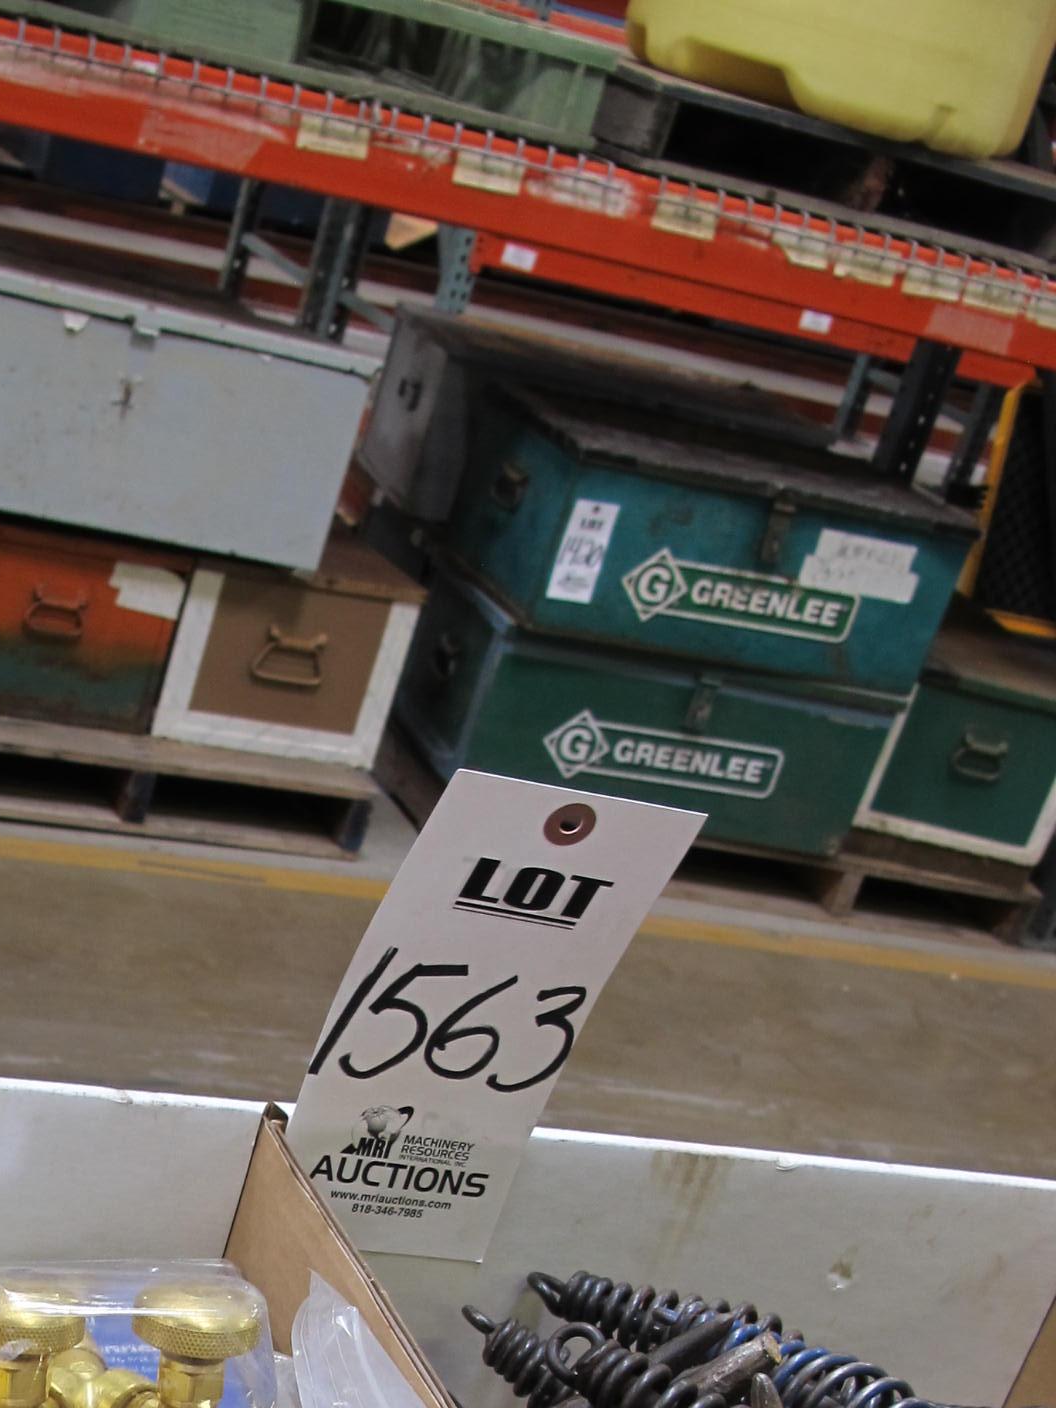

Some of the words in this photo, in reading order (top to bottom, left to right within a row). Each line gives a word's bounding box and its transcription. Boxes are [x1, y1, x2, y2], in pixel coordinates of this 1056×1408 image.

[691, 579, 842, 627] GREENLEE
[613, 740, 764, 783] GREENLEE
[459, 857, 614, 920] LOT
[307, 946, 587, 1093] 1563
[358, 1138, 393, 1159] MRI
[404, 1135, 476, 1151] MACHINERY
[401, 1145, 469, 1161] RESOURCES
[310, 1155, 489, 1197] AUCTIONS
[331, 1189, 451, 1209] www.mriauctions.com
[352, 1204, 424, 1218] 818-346-7985
